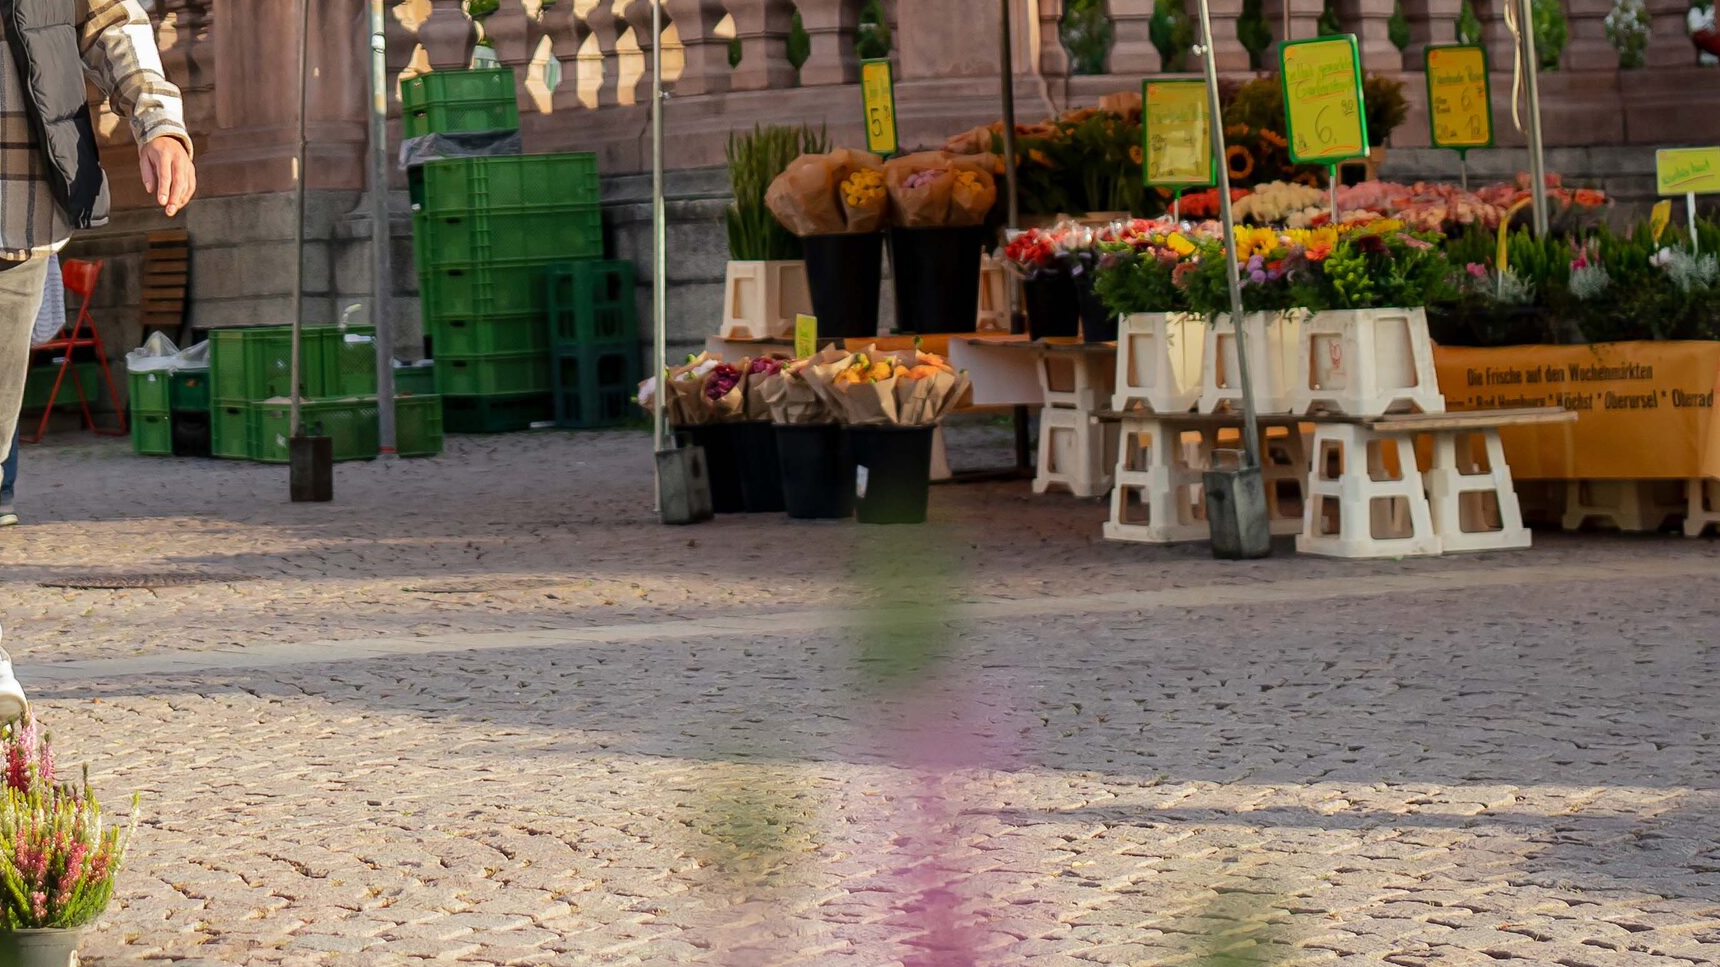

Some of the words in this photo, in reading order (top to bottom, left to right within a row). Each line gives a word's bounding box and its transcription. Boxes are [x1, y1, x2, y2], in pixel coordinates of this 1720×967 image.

[1467, 368, 1483, 386] Die
[1486, 365, 1522, 385] Frische
[1526, 364, 1543, 383] auf
[1545, 364, 1565, 382] den
[1568, 362, 1654, 381] Wochenmärkten
[1556, 391, 1593, 410] Höchst
[1604, 389, 1659, 409] Oberursel
[1671, 387, 1714, 408] Oberrad
